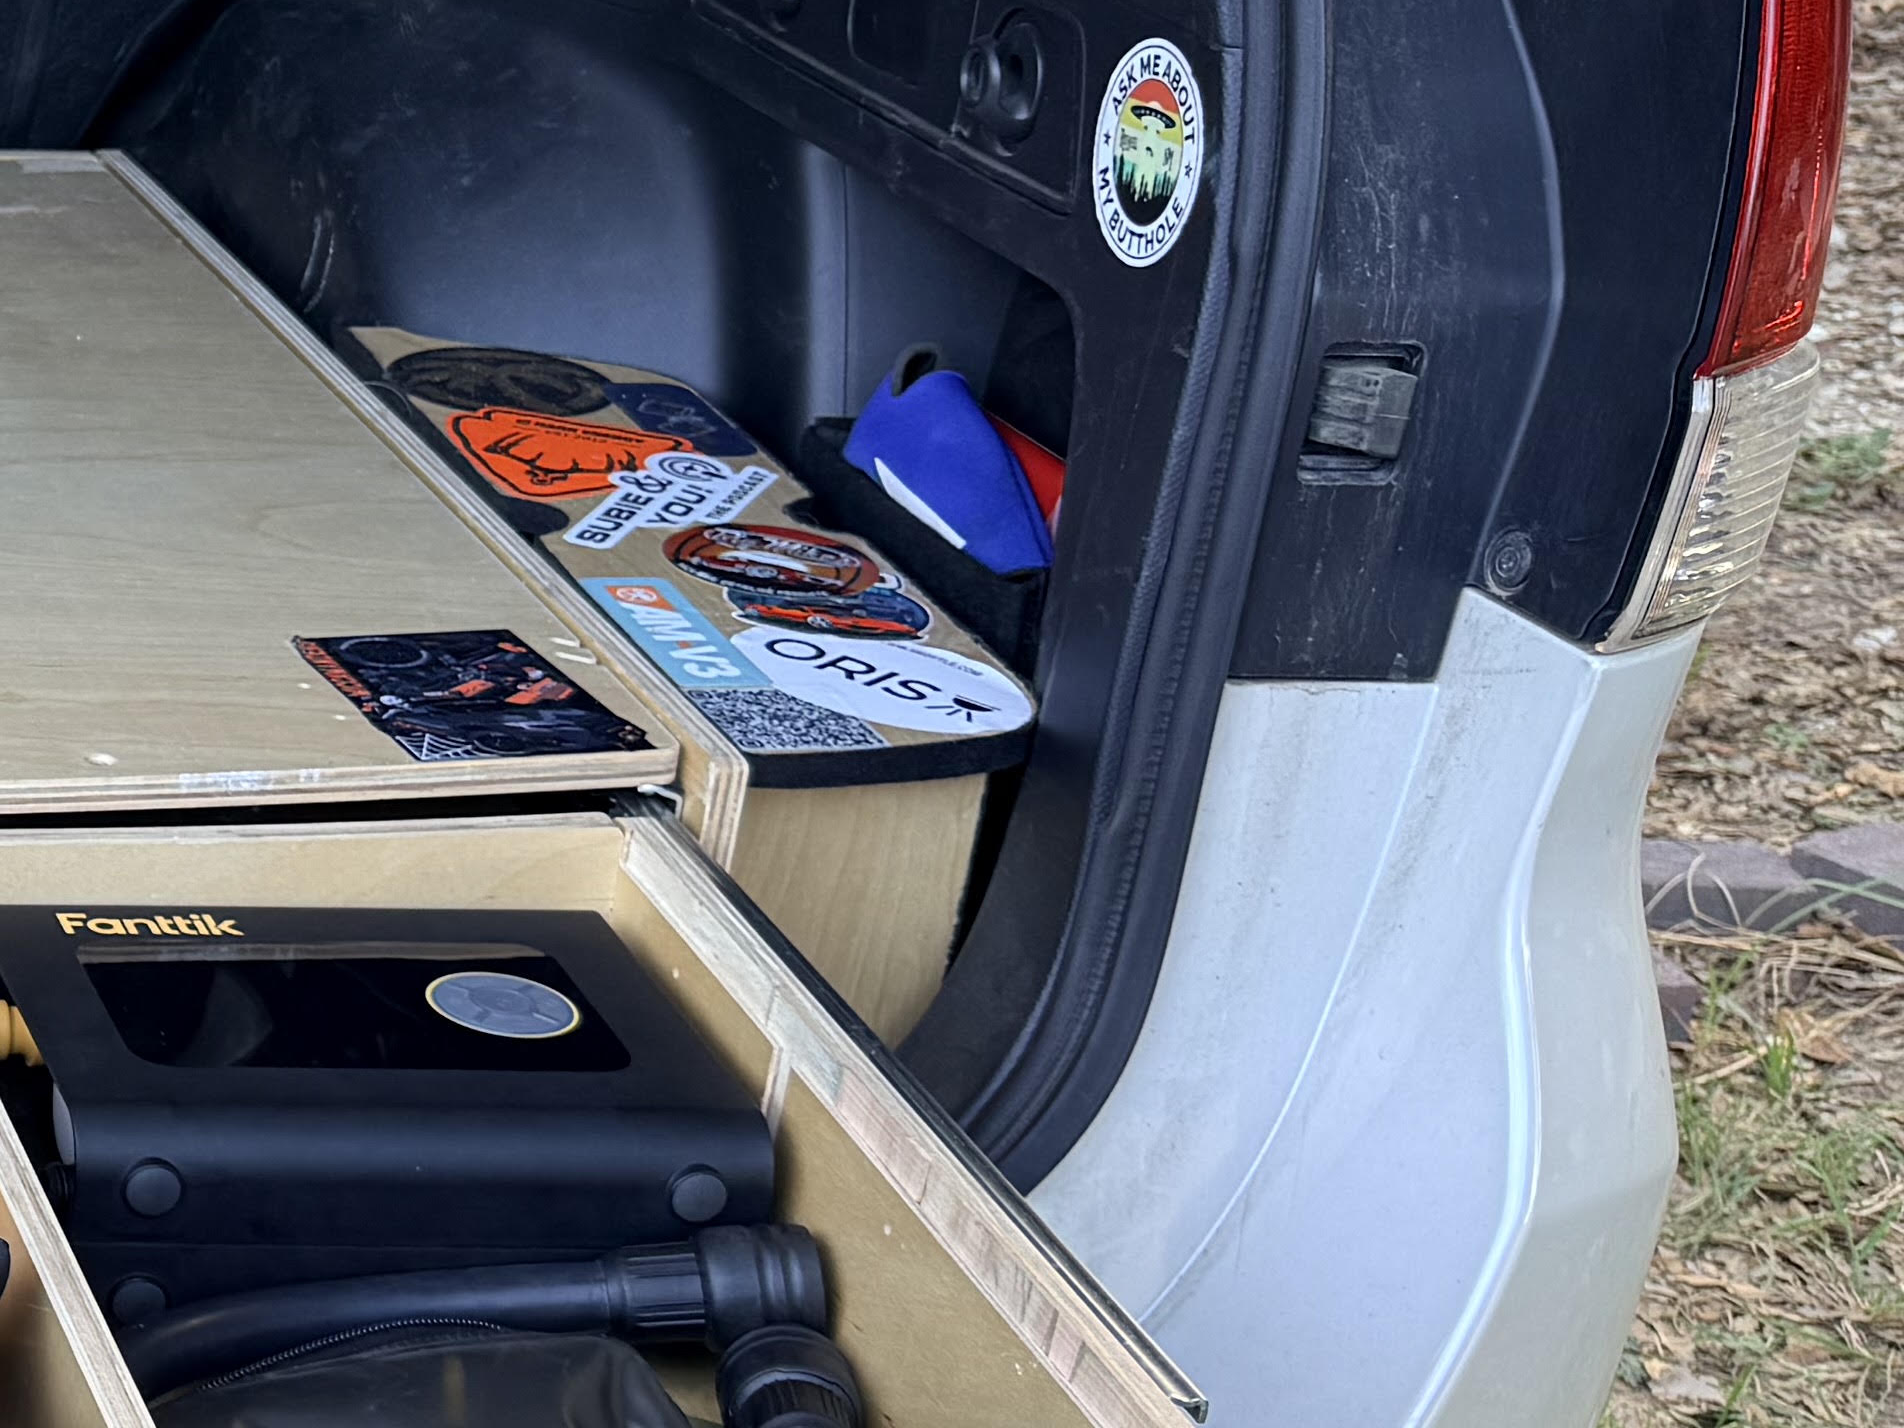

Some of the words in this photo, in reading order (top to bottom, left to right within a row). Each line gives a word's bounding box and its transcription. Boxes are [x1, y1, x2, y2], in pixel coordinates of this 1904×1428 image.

[1112, 66, 1138, 115] ASK
[1140, 54, 1161, 76] ME
[1162, 61, 1195, 144] ABOUT
[1097, 168, 1116, 206] MY
[1109, 197, 1183, 255] BUTTHOLE
[577, 492, 645, 543] SUBIE
[646, 484, 715, 526] YOU!
[763, 637, 943, 703] ORIS
[56, 911, 245, 938] Fanttik
